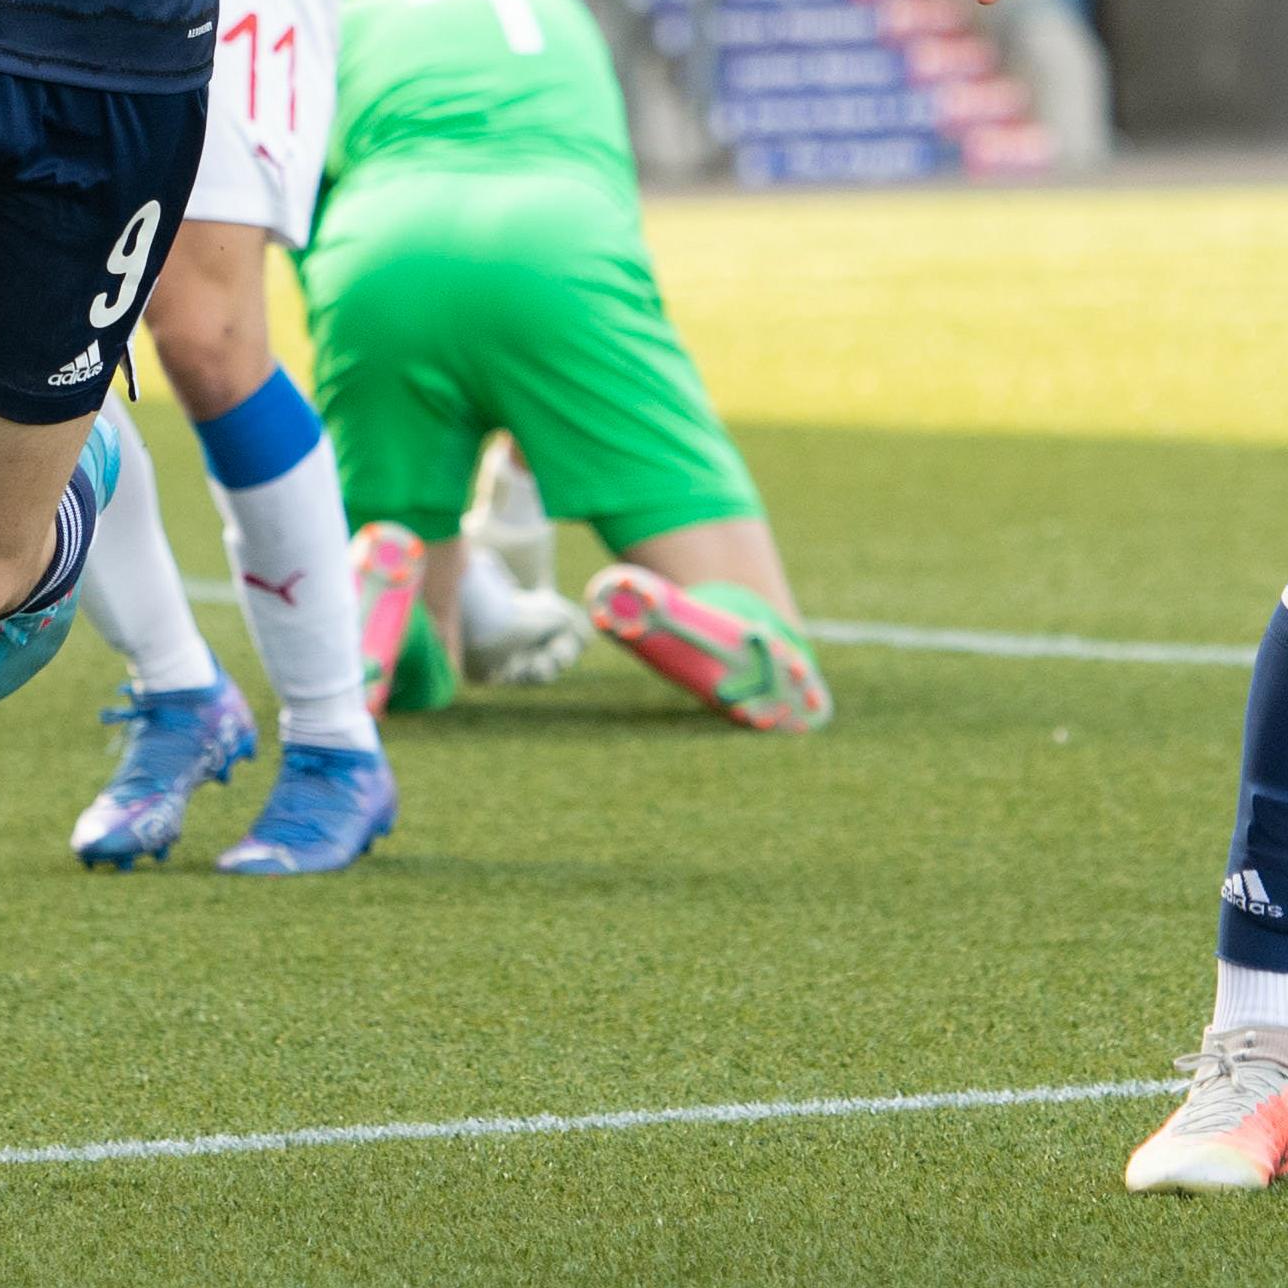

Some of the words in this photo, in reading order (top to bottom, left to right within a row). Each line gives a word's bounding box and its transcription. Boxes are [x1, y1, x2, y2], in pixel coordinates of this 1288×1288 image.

[222, 13, 296, 132] 11
[89, 199, 161, 329] 9
[47, 361, 104, 387] adidas
[1220, 884, 1284, 919] adidas
